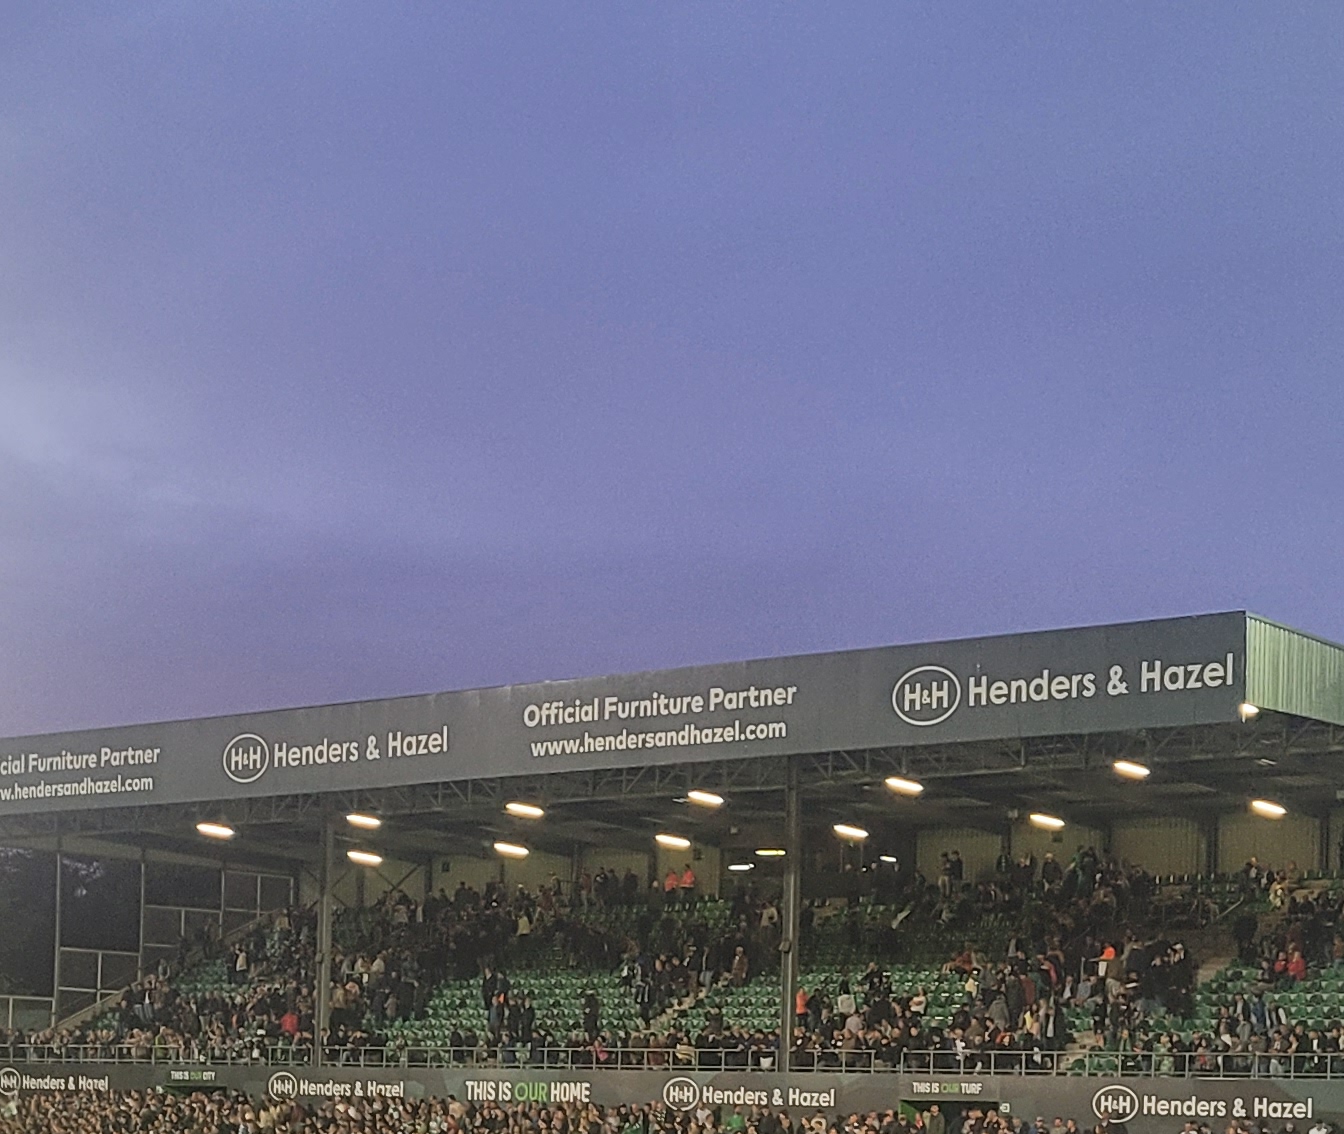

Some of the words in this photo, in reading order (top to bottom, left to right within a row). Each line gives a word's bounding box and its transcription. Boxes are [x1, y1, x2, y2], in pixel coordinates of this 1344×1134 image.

[903, 680, 949, 712] H&H
[968, 669, 1096, 707] Henders
[1107, 664, 1129, 696] &
[1141, 652, 1234, 693] Hazel
[523, 698, 599, 728] Official
[604, 692, 704, 720] Furniture
[709, 685, 798, 712] Partner
[230, 745, 262, 771] H&H
[273, 738, 359, 768] Henders
[365, 735, 381, 761] &
[388, 725, 448, 758] Hazel
[531, 720, 787, 757] www.hendersandhazel.com
[28, 750, 98, 773] Furniture
[100, 746, 161, 768] Partner
[22, 1075, 66, 1091] Henders
[68, 1076, 76, 1091] &
[78, 1076, 109, 1091] Hazel
[299, 1079, 351, 1097] Henders
[354, 1081, 364, 1097] &
[367, 1080, 404, 1097] Hazel
[465, 1080, 496, 1100] THIS
[498, 1081, 512, 1101] IS
[514, 1082, 547, 1102] OUR
[550, 1082, 591, 1103] HOME
[912, 1082, 931, 1094] THIS
[931, 1082, 940, 1094] IS
[961, 1082, 983, 1094] TURF
[702, 1086, 768, 1106] Henders
[772, 1088, 784, 1107] &
[788, 1088, 836, 1107] Hazel
[1100, 1095, 1131, 1114] H&H
[1143, 1095, 1227, 1117] Henders
[1232, 1098, 1246, 1118] &
[1254, 1097, 1313, 1119] Hazel
